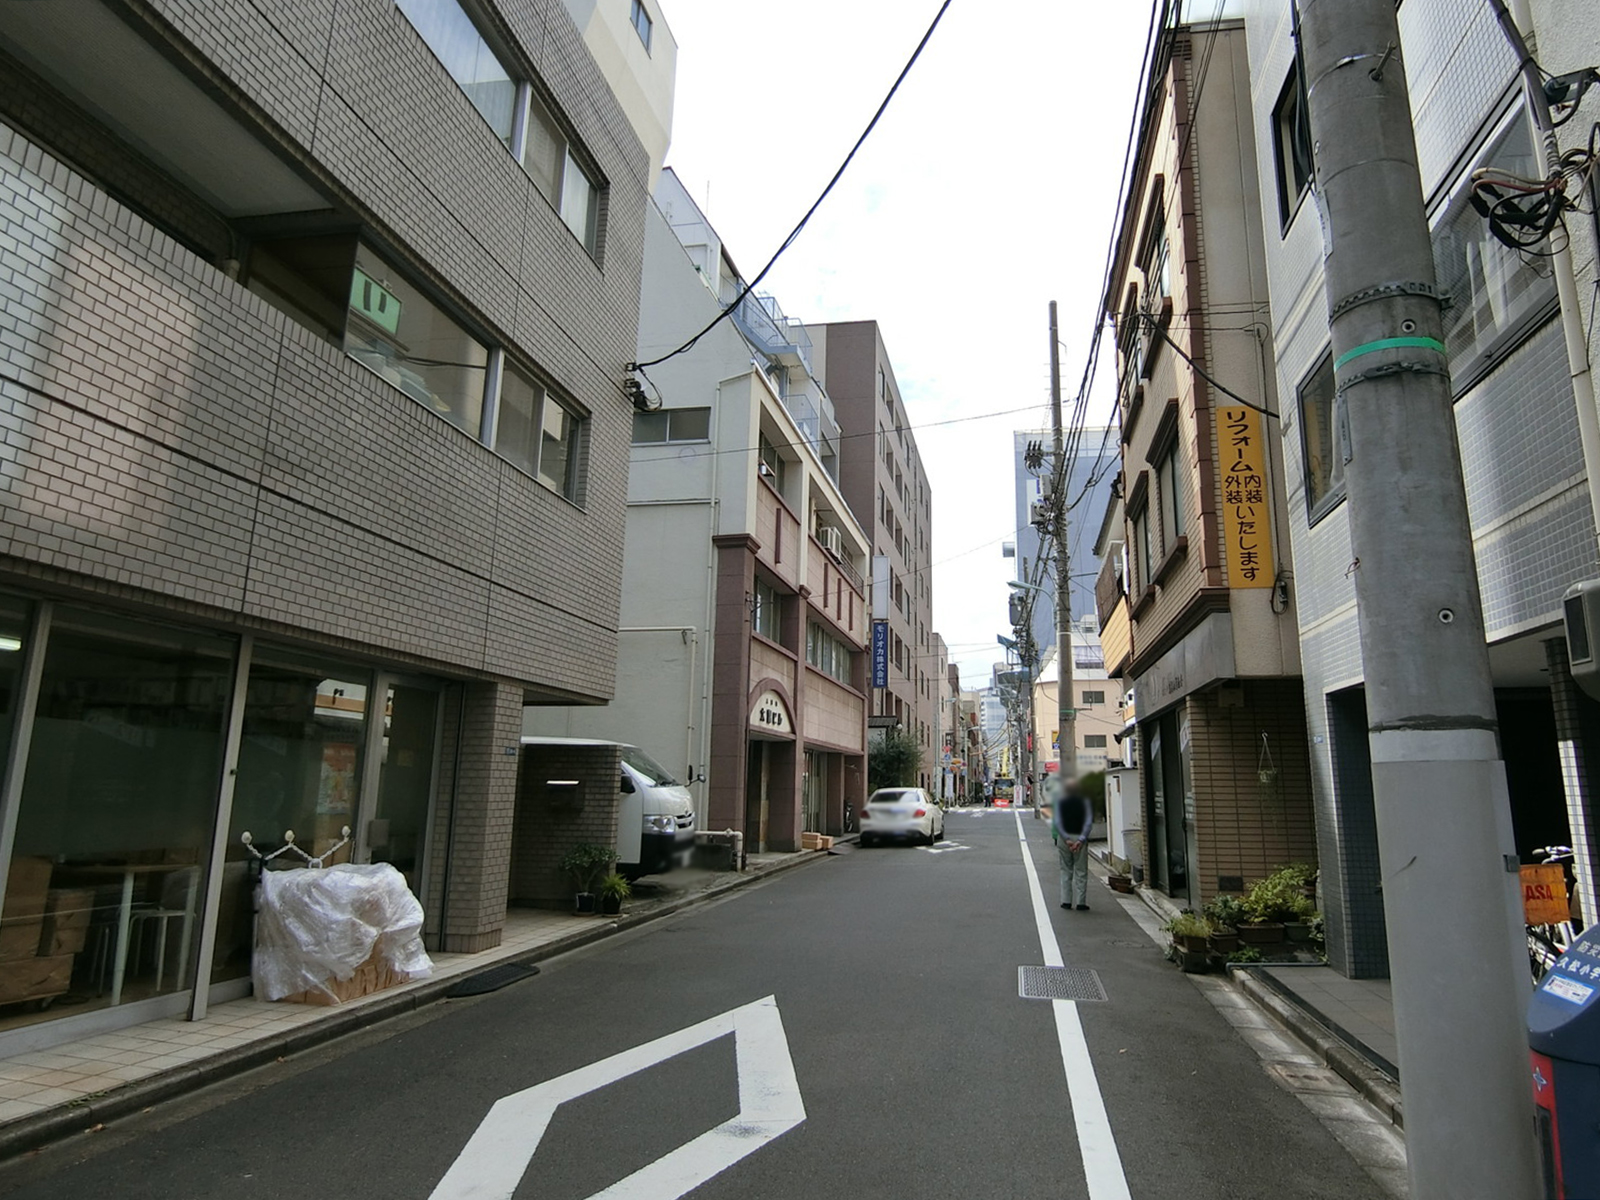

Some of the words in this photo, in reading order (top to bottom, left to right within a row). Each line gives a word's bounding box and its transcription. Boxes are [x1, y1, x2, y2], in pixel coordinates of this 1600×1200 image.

[1226, 410, 1253, 472] リフォーム
[1224, 475, 1244, 505] 外装
[1244, 474, 1263, 504] 内装
[1236, 505, 1260, 582] いたします
[876, 625, 885, 685] モリオカ株式会社
[1525, 884, 1554, 902] ASA
[1576, 940, 1600, 959] 防災
